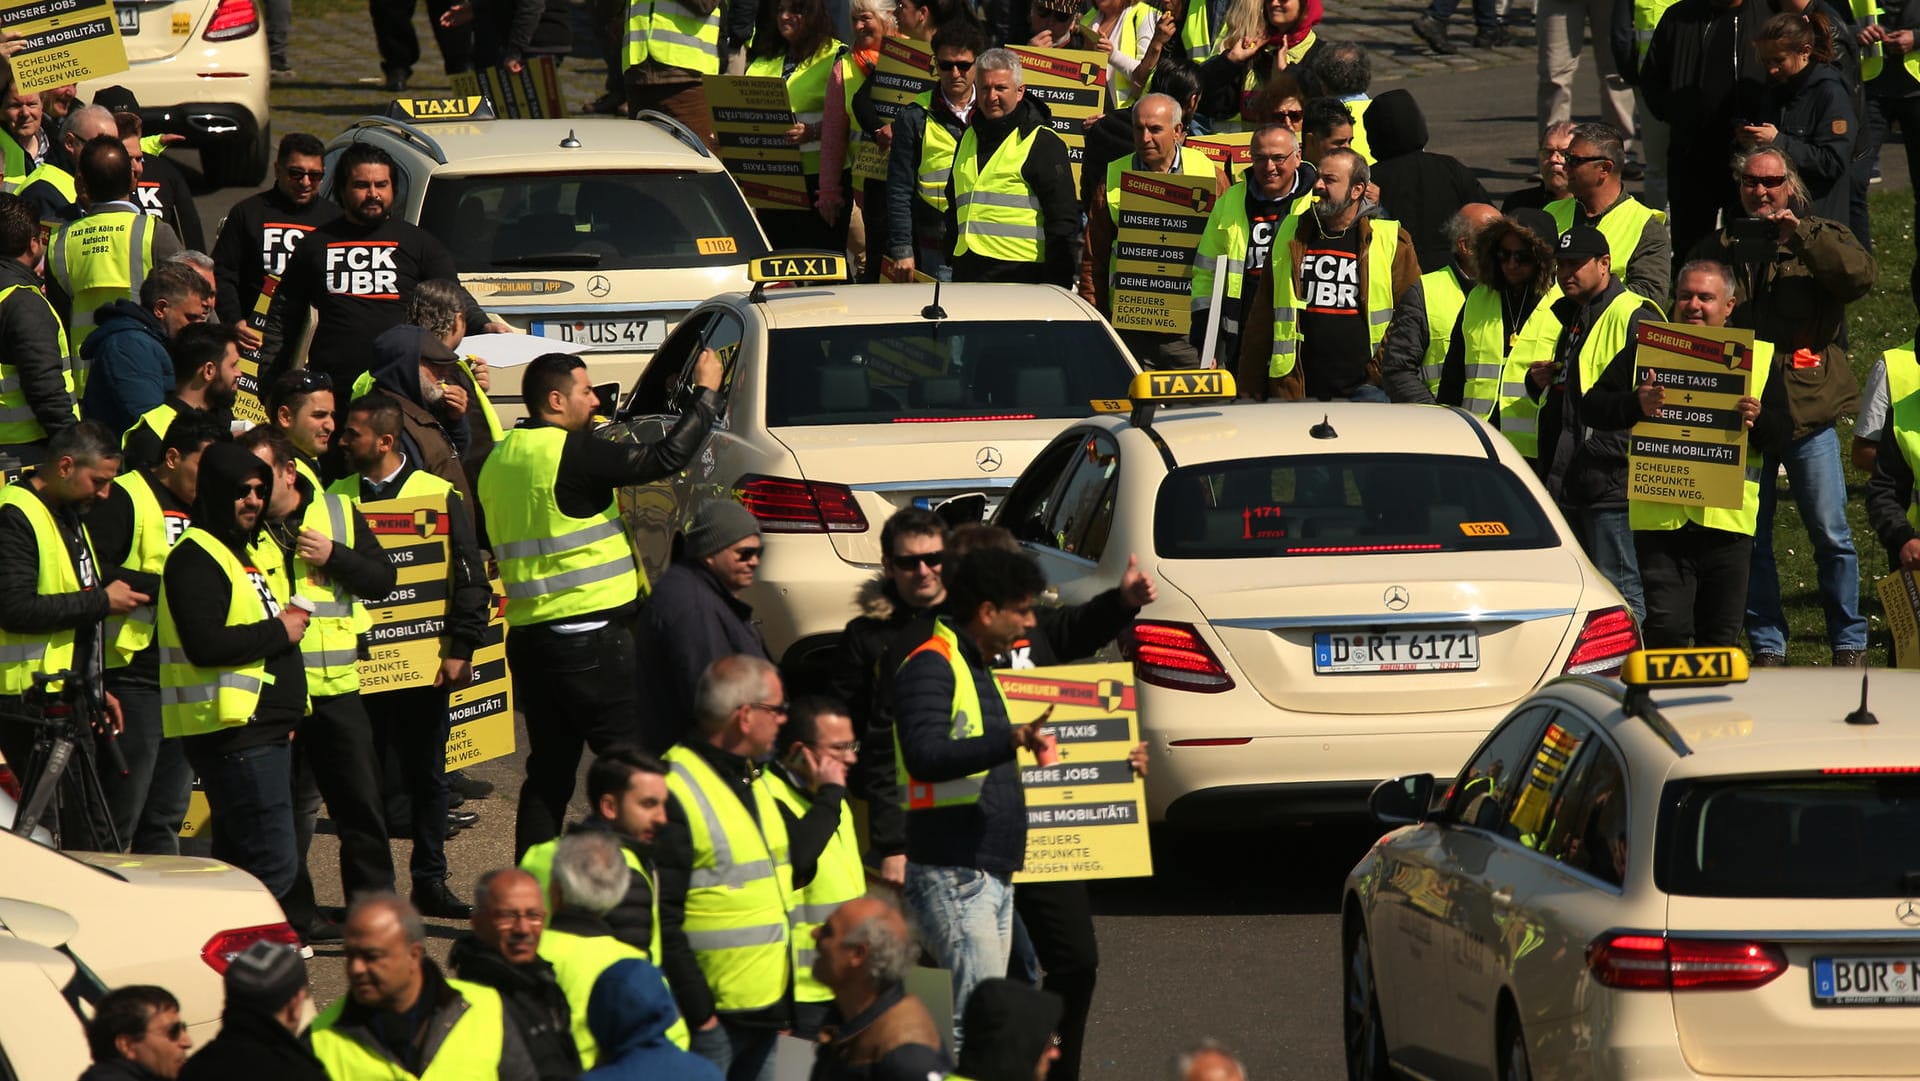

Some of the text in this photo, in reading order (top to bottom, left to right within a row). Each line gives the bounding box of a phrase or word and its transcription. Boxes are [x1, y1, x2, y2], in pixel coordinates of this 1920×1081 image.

[3, 0, 76, 22] UNSERE JOBS
[46, 23, 106, 44] MOBILITÄT!
[16, 50, 70, 69] SCHEUERS
[19, 58, 79, 80] ECKPUNKTE
[22, 67, 92, 90] MÜSSEN WEG.
[902, 80, 922, 90] TAXIS
[1047, 90, 1075, 100] TAXIS
[416, 98, 465, 114] TAXI
[1123, 214, 1188, 228] UNSERE TAXIS
[71, 229, 84, 239] TAXI
[82, 236, 109, 246] Aufsicht
[263, 228, 304, 252] FC
[1561, 234, 1571, 248] S
[704, 239, 733, 253] 1102
[1122, 246, 1184, 260] UNSERE JOBS
[326, 247, 398, 271] FCK
[770, 259, 827, 276] TAXI
[1301, 255, 1357, 283] FCK
[326, 270, 399, 294] UBR
[544, 281, 561, 292] APP
[1120, 276, 1192, 291] DEINE MOBILITÄ
[1118, 294, 1165, 306] SCHEUERS
[1117, 306, 1169, 317] ECKPUNKTE
[1116, 315, 1177, 328] MÜSSEN WEG.
[560, 320, 648, 343] D US 47
[1153, 375, 1219, 395] TAXI
[1642, 371, 1718, 388] USERE TAXIS
[1103, 401, 1121, 410] 53
[1684, 410, 1713, 423] JOBS
[1636, 441, 1733, 459] DEINE MOBILITÄT!
[1635, 462, 1690, 475] SCHEUERS
[1634, 473, 1695, 488] ECKPUNKTE
[1633, 484, 1705, 501] MÜSSEN WEG.
[1254, 506, 1281, 518] 171
[1469, 523, 1504, 535] 1330
[388, 551, 414, 564] XIS
[374, 620, 444, 640] MOBILITÄT!
[1333, 633, 1474, 662] D RT 6171
[357, 660, 409, 675] KPUNKTE
[1649, 653, 1729, 678] TAXI
[360, 671, 423, 687] SSEN WEG.
[1003, 681, 1094, 699] SCHEUERWEHR
[449, 699, 501, 722] MOBILITÄT!
[1058, 725, 1098, 737] TAXIS
[459, 749, 482, 762] WEG.
[1063, 767, 1099, 782] JOBS
[1028, 805, 1130, 823] INE MOBILITÄT!
[1025, 834, 1081, 846] CHEUERS
[1025, 849, 1090, 860] CKPUNKTE
[1072, 861, 1104, 873] WEG.
[1835, 961, 1889, 992] BOR
